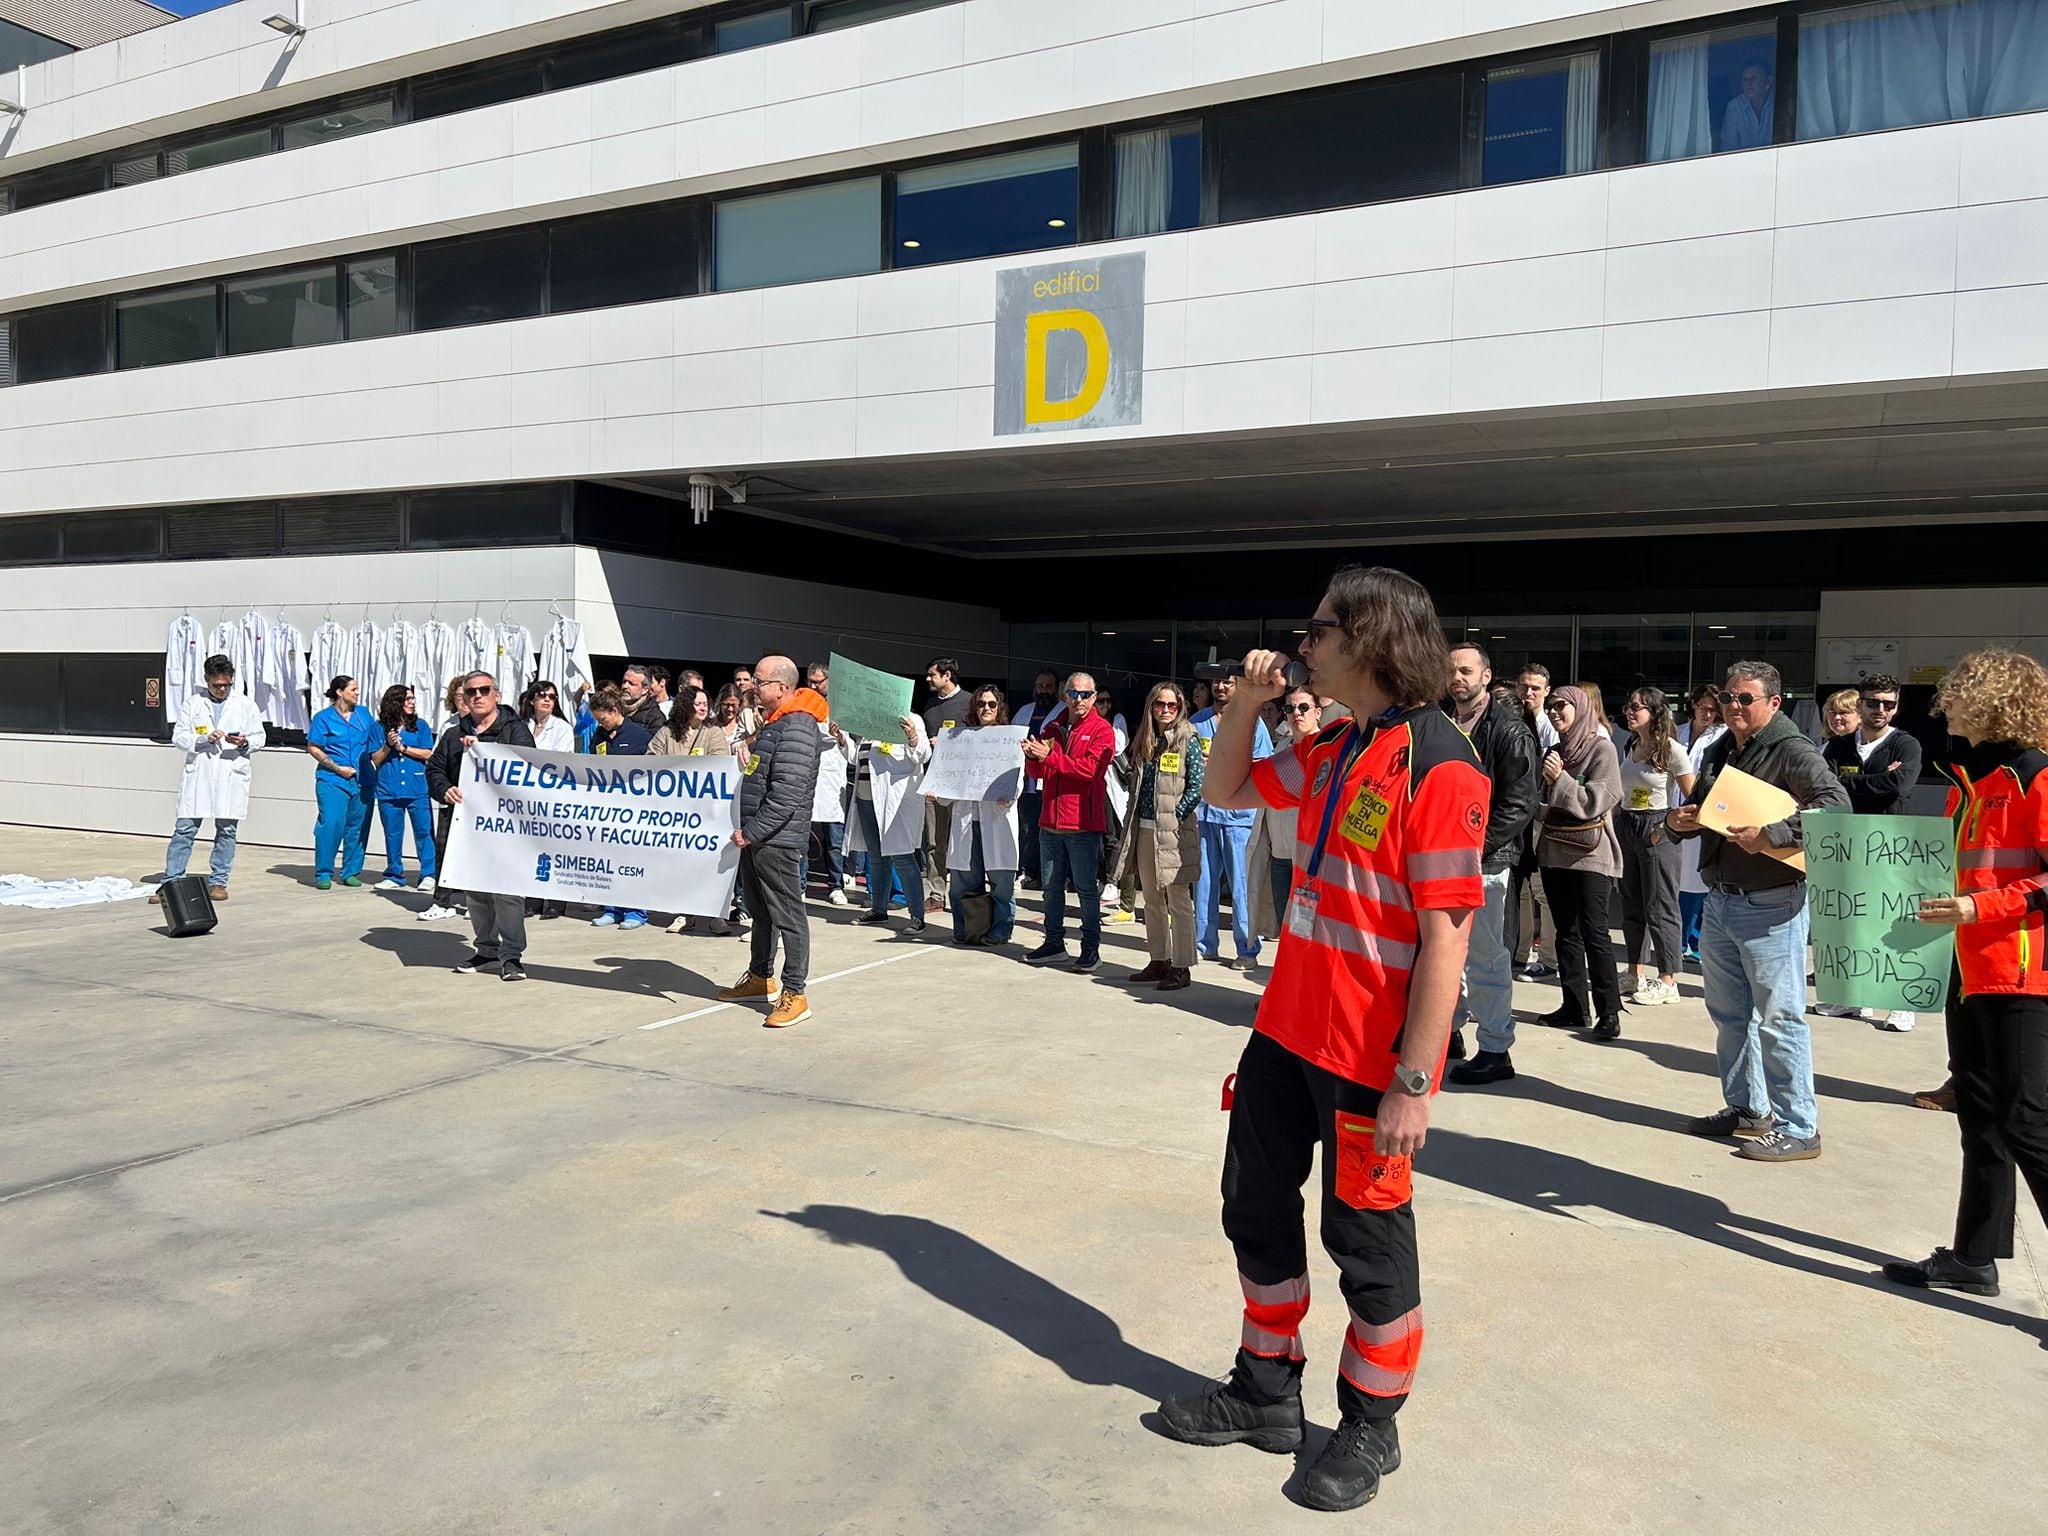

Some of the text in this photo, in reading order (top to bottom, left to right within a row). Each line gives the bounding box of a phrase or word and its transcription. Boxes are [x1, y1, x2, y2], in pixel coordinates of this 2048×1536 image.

[1033, 266, 1101, 298] edifici
[1025, 308, 1111, 425] D
[474, 757, 736, 800] HUELGA NACIONAL
[498, 798, 702, 829] POR UN ESTATUTO PROPIO
[1345, 811, 1378, 840] HUELGA
[1358, 806, 1372, 821] EN
[475, 816, 719, 852] PARA MÉDICOS Y FACULTATIVOS
[554, 853, 645, 877] SIMEBAL CESM
[1865, 830, 1951, 873] PARAR,
[1809, 884, 1866, 920] PUEDE
[1907, 985, 1935, 1005] 24
